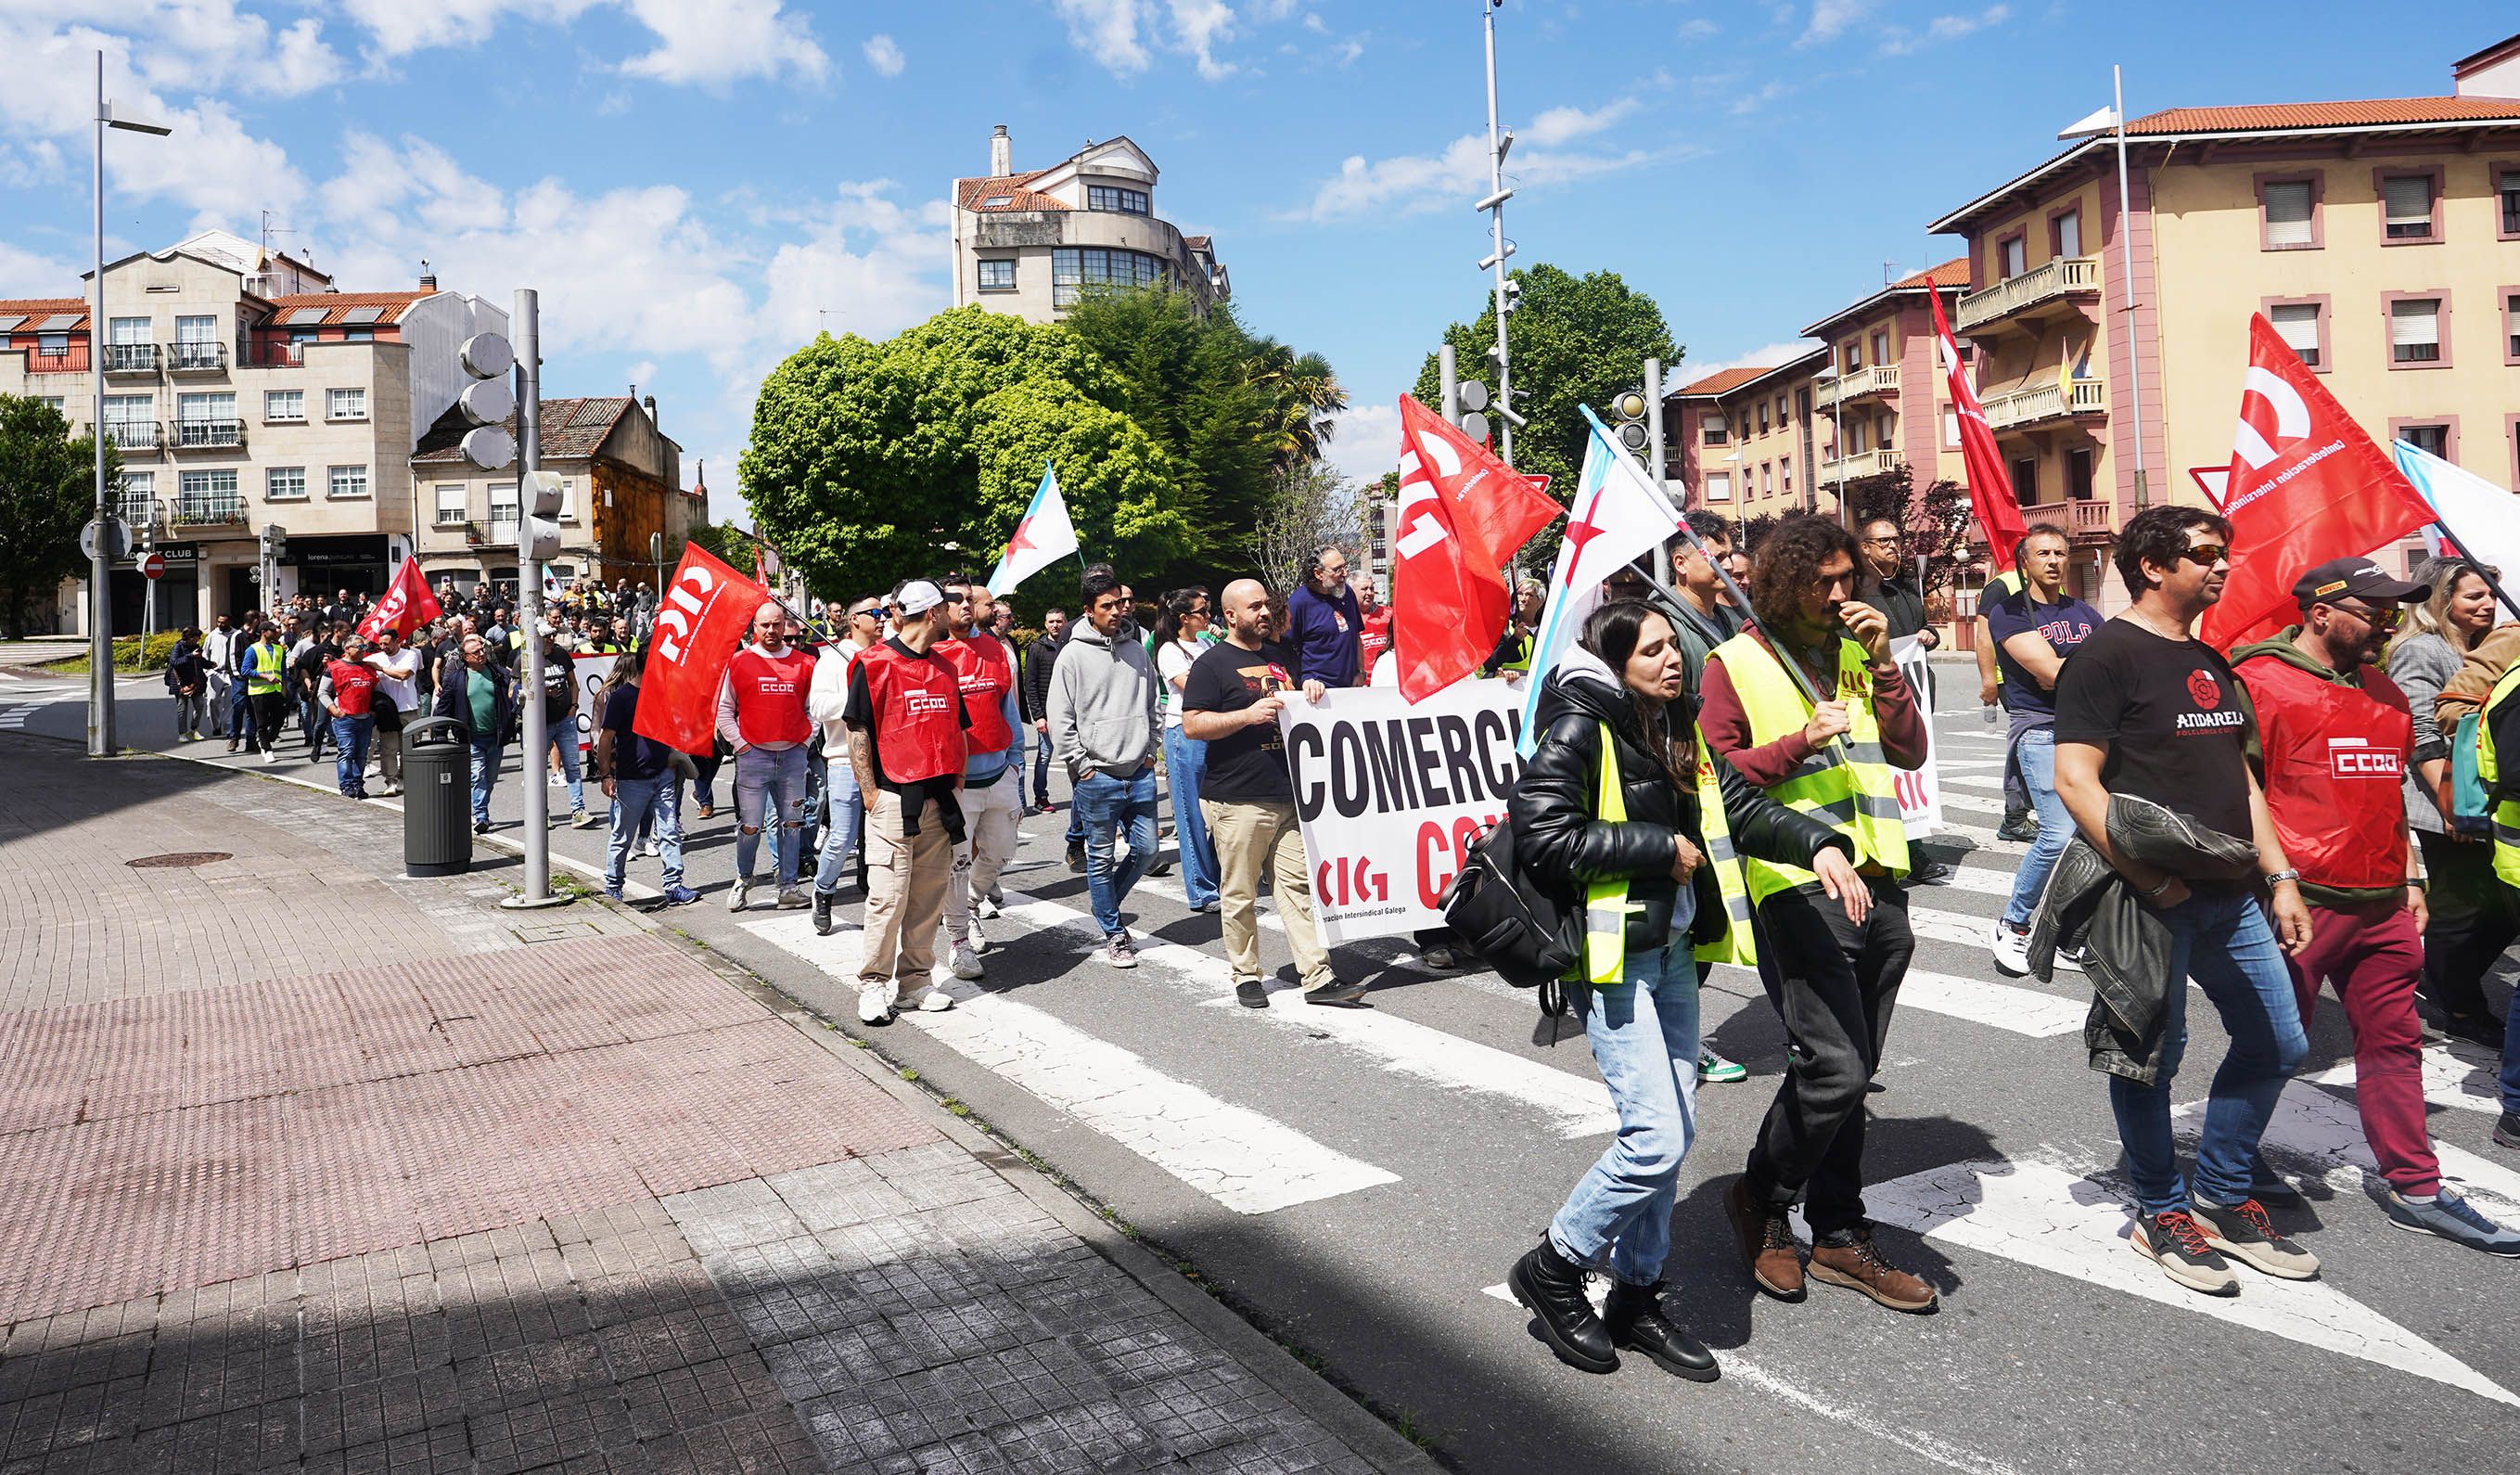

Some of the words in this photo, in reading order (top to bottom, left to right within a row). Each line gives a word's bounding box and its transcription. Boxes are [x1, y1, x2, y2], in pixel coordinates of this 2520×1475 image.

[761, 684, 795, 692] CCOO
[910, 698, 947, 711] CCOO
[2336, 753, 2398, 772] CCOO
[1317, 855, 1388, 907] CIG
[1344, 908, 1384, 919] Intersindical
[1385, 905, 1406, 916] Galega
